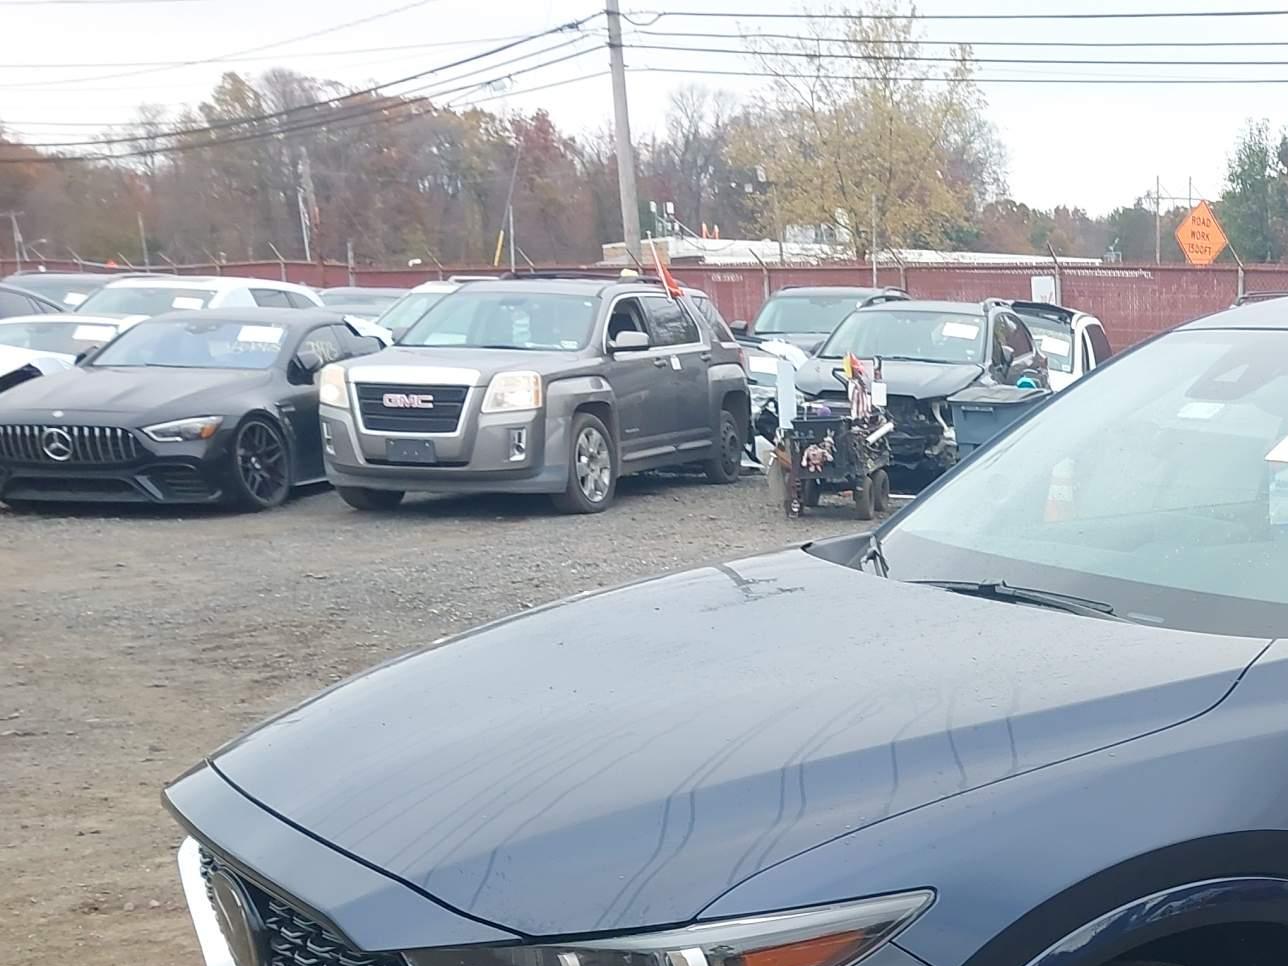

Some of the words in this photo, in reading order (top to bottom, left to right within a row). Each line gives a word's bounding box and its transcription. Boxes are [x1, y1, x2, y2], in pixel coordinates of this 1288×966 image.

[1191, 215, 1211, 228] ROAD
[1190, 230, 1210, 241] WORK
[383, 393, 434, 408] GMC
